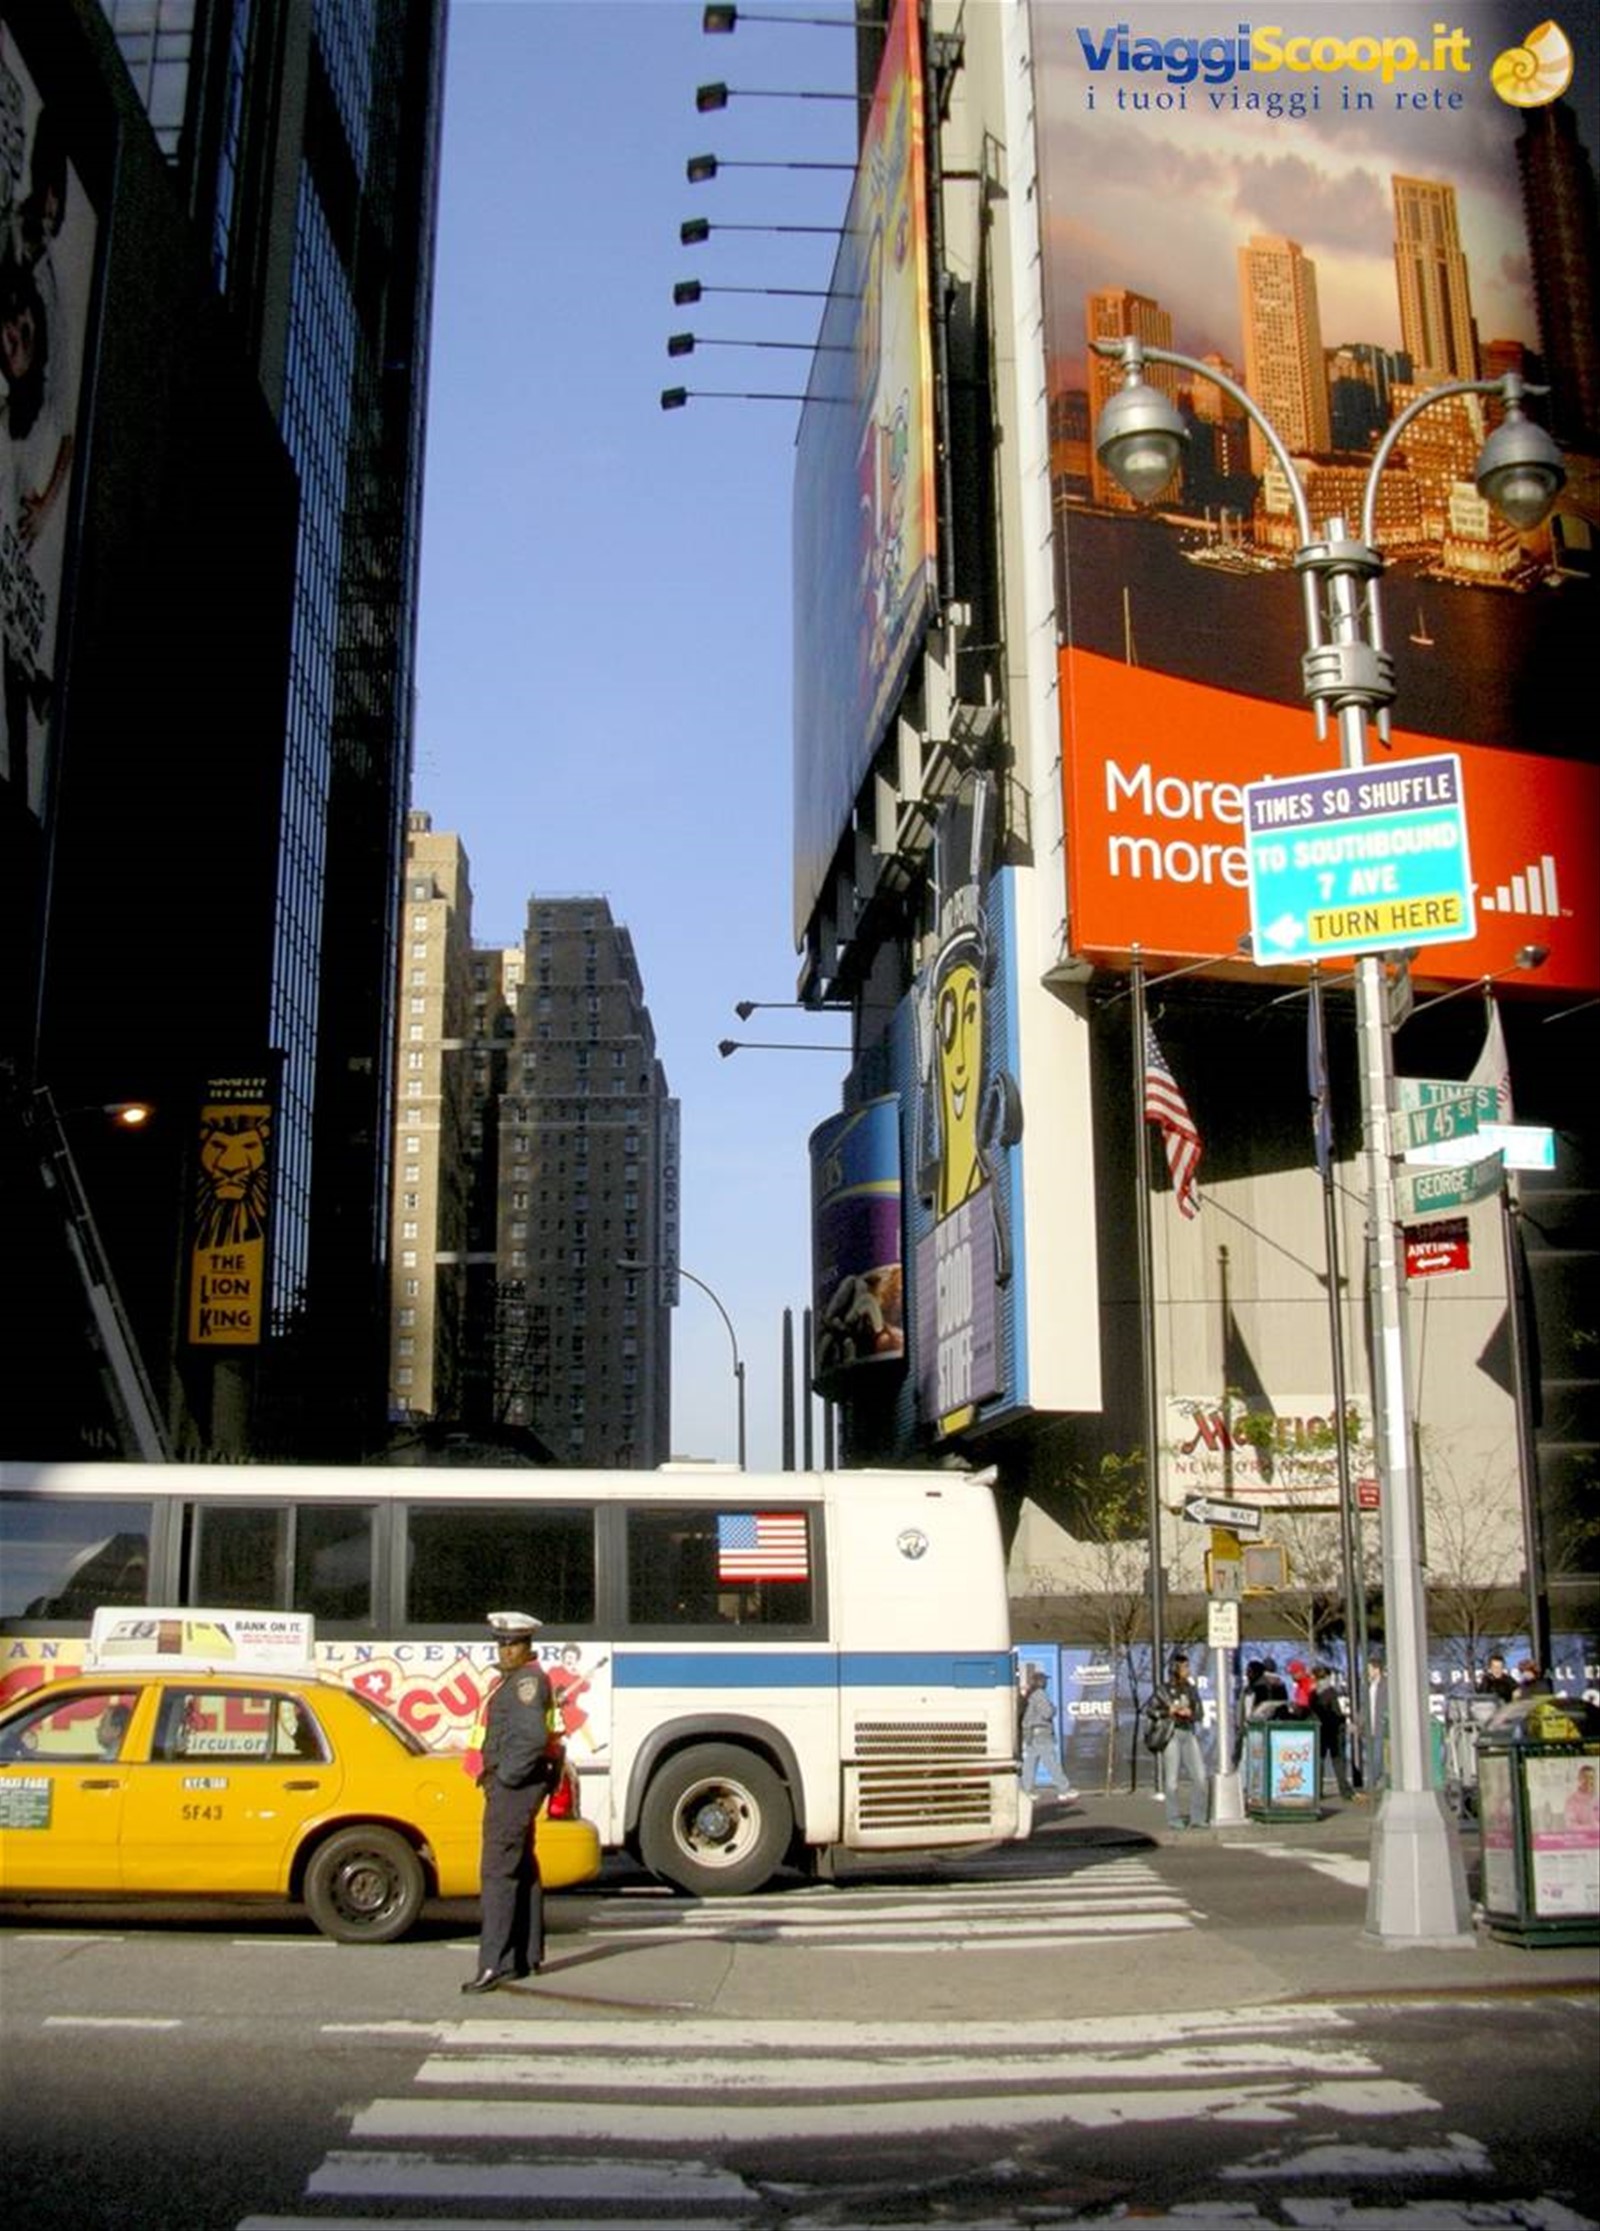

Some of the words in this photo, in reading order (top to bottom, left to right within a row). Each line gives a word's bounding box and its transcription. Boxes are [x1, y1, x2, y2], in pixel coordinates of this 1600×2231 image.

[1105, 760, 1243, 824] More
[1254, 793, 1314, 825] TIMES
[1322, 788, 1350, 815] SQ
[1358, 773, 1451, 810] SHUFFLE
[1109, 836, 1248, 887] more
[1256, 844, 1287, 875] TO
[1292, 821, 1458, 870] SOUTHBOUND
[1316, 871, 1335, 900] 7
[1348, 864, 1399, 897] AVE
[1314, 909, 1379, 938] TURN
[1391, 898, 1459, 930] HERE
[1413, 1111, 1428, 1143] W
[1433, 1104, 1455, 1138] 45
[1458, 1100, 1473, 1118] ST
[1416, 1169, 1468, 1200] GEORGE
[210, 1254, 245, 1271] THE
[201, 1274, 250, 1304] LION
[200, 1308, 252, 1337] KING
[235, 1620, 267, 1631] BANK
[270, 1621, 286, 1632] ON
[395, 1644, 561, 1662] CENTR
[1067, 1701, 1112, 1715] CBRE
[182, 1804, 222, 1820] 5F43
